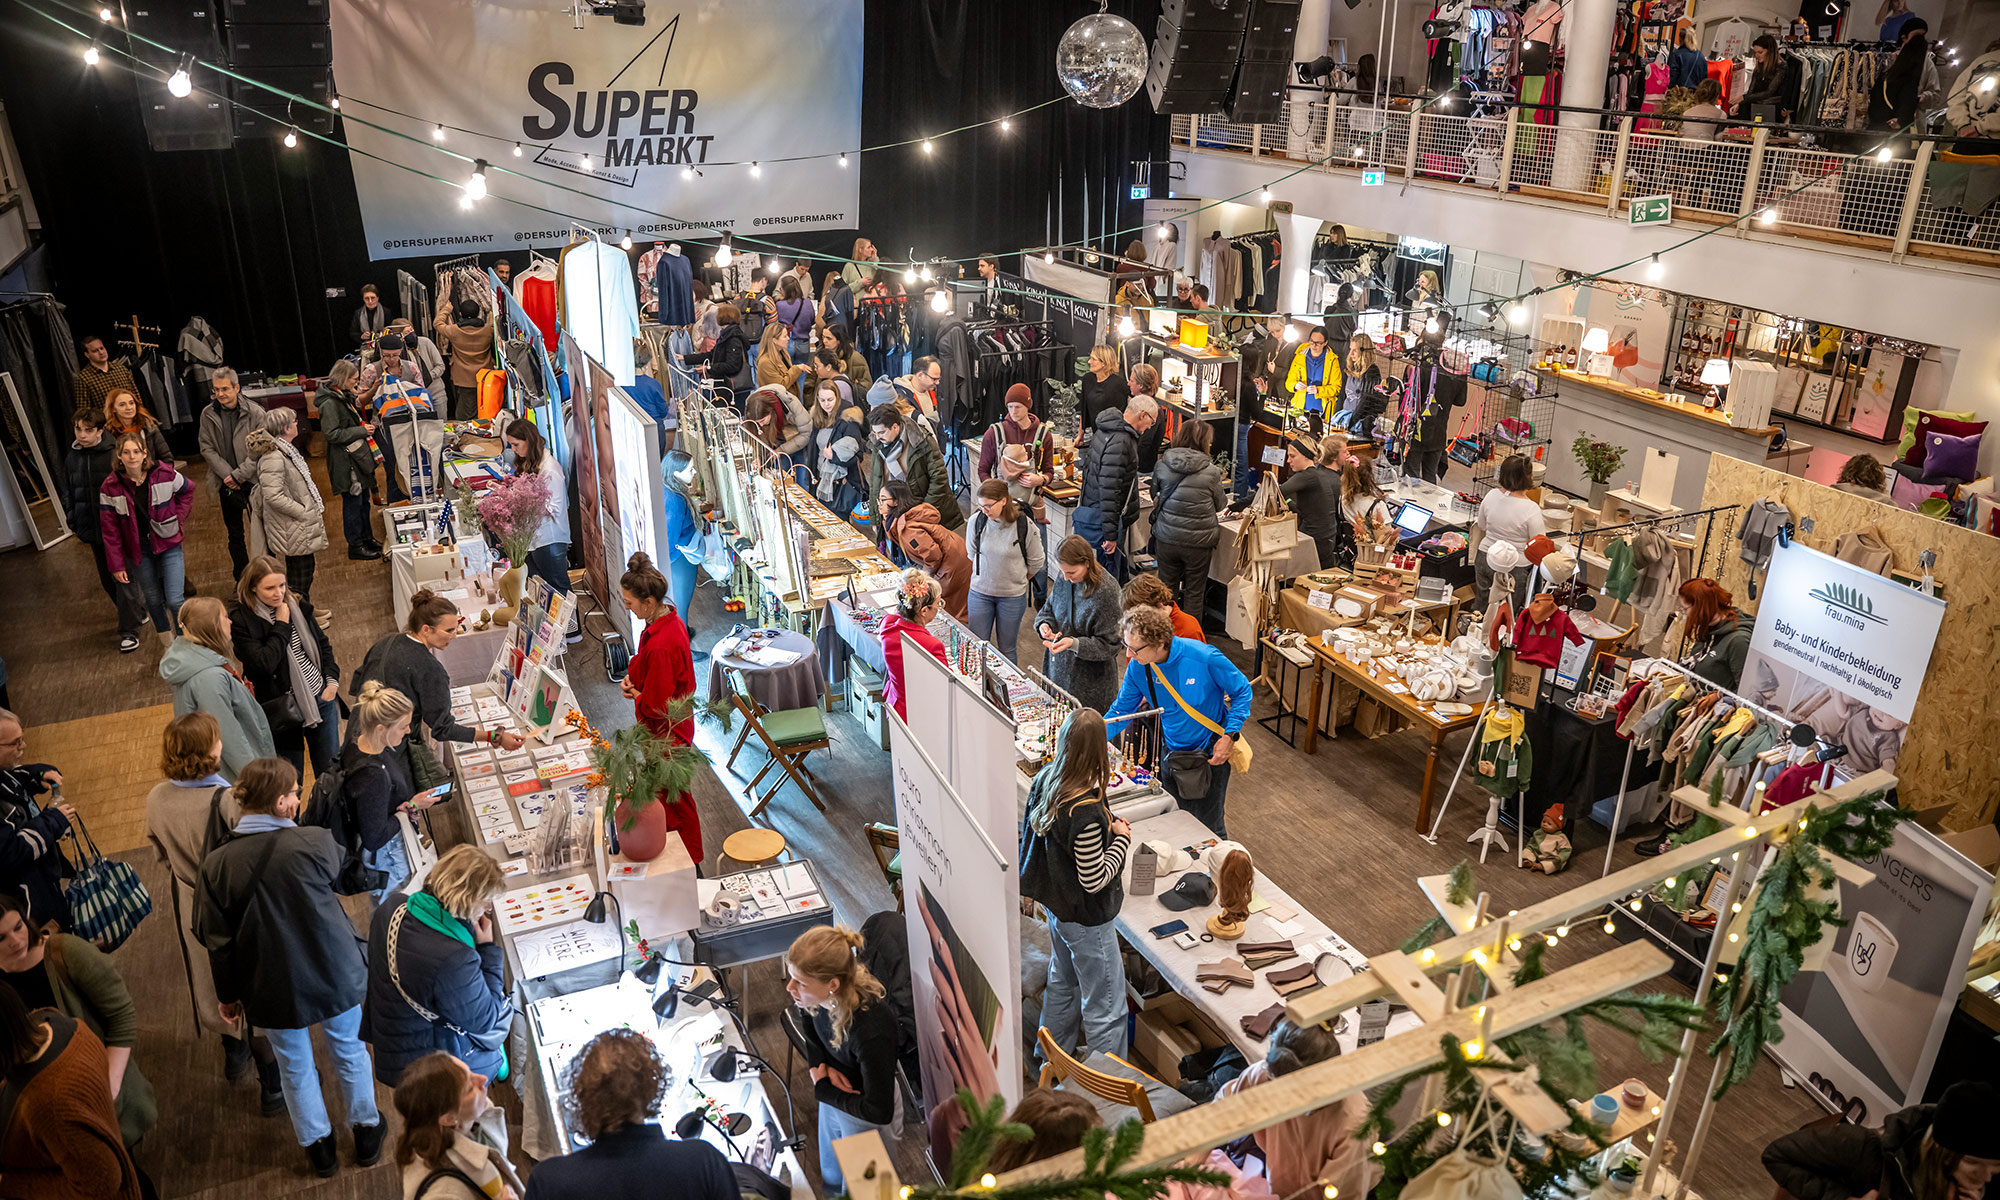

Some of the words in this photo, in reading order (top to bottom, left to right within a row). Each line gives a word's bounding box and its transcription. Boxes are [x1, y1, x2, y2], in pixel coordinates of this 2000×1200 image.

[522, 61, 699, 141] SUPER
[604, 135, 715, 168] MARKT
[611, 173, 630, 184] Design
[637, 219, 736, 234] @DERSUPERMARKT
[752, 213, 845, 227] @DERSUPERMARKT
[382, 234, 495, 250] @DERSUPERMARKT
[1824, 604, 1866, 632] frau.mina
[1773, 638, 1816, 663] genderneutral
[1820, 659, 1853, 683] nachhaltig
[1857, 677, 1893, 701] ökologisch
[1774, 618, 1800, 641] Baby-
[1801, 632, 1820, 649] und
[1819, 638, 1902, 690] Kinderbekleidung
[898, 758, 922, 806] laura
[901, 792, 952, 876] christmann
[903, 815, 943, 888] jewellery
[550, 932, 575, 961] TIERE
[569, 928, 595, 955] WILDE
